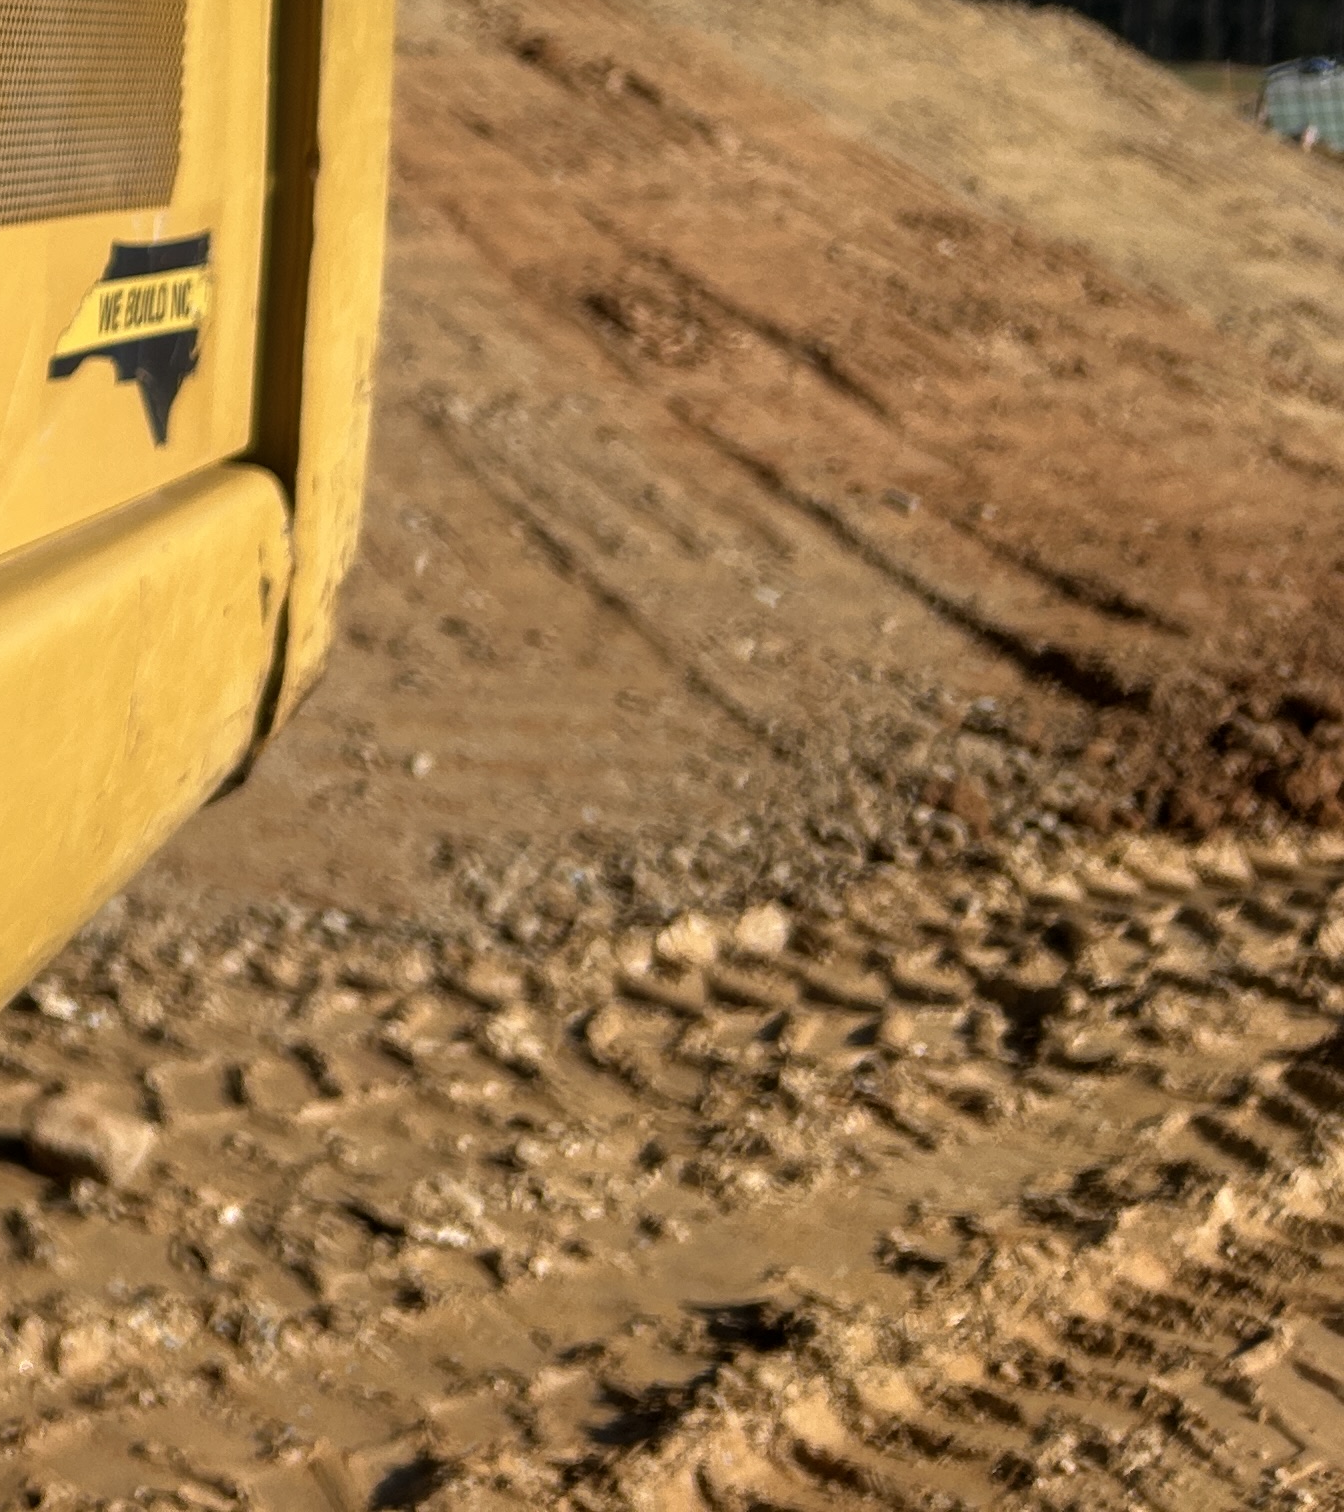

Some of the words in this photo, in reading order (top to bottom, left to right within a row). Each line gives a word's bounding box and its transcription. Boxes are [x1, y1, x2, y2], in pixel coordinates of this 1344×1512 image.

[99, 290, 123, 333] WE
[124, 284, 167, 328] BUILD
[170, 279, 191, 320] NC
